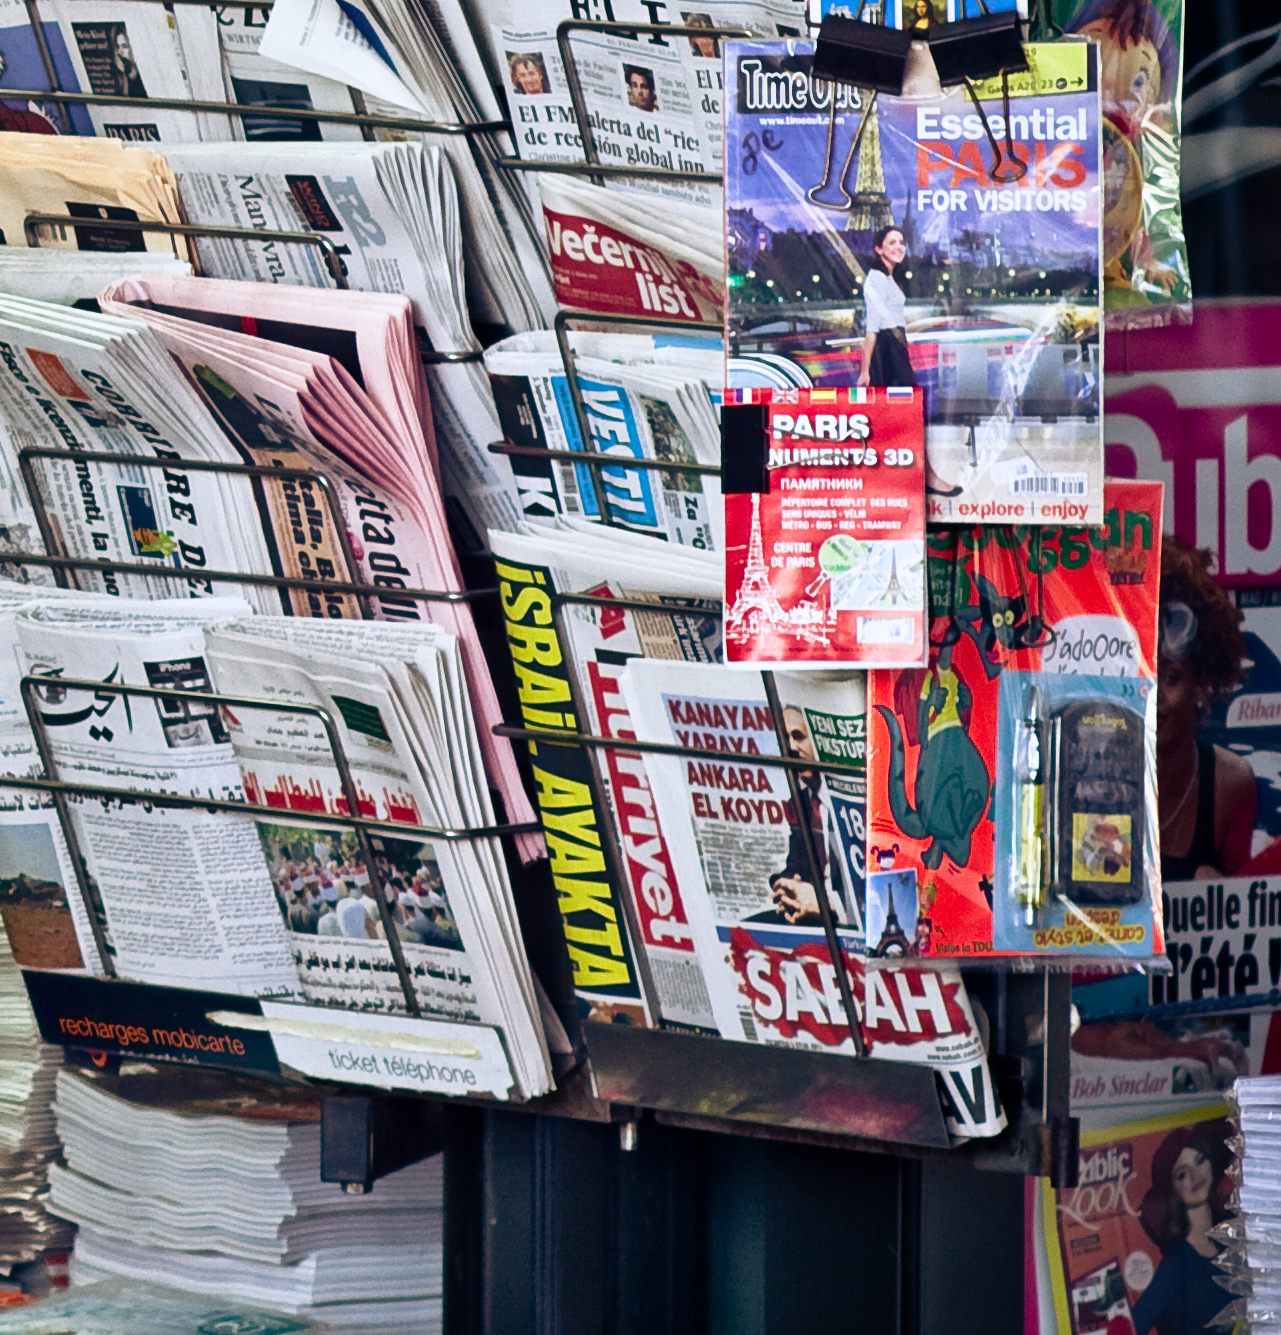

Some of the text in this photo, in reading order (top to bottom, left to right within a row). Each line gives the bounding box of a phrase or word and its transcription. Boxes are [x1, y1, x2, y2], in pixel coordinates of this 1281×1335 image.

[740, 59, 808, 110] Time
[518, 104, 542, 123] El
[916, 107, 1088, 142] Essential
[636, 121, 660, 143] del
[524, 127, 675, 172] de global
[916, 141, 1088, 188] PARIS
[917, 189, 1088, 212] FOR VISITORS
[636, 273, 695, 319] list
[772, 414, 870, 440] PARIS
[884, 448, 914, 466] 3D
[780, 478, 863, 490] ПАМЯТНИКИ
[830, 497, 866, 508] COMPLET
[957, 498, 1090, 522] explore enjoy
[816, 520, 902, 530] BUS TRAMWAY
[774, 542, 812, 554] CENTRE
[770, 556, 815, 568] DE PARIS
[687, 763, 773, 794] ANKARA
[693, 794, 720, 821] EL
[532, 773, 630, 989] AYAKTA
[747, 956, 952, 1036] SABAH
[58, 1014, 246, 1057] recharges mobicarte
[328, 1048, 477, 1088] ticket téléphone
[1072, 1075, 1168, 1101] Bob Sinclar
